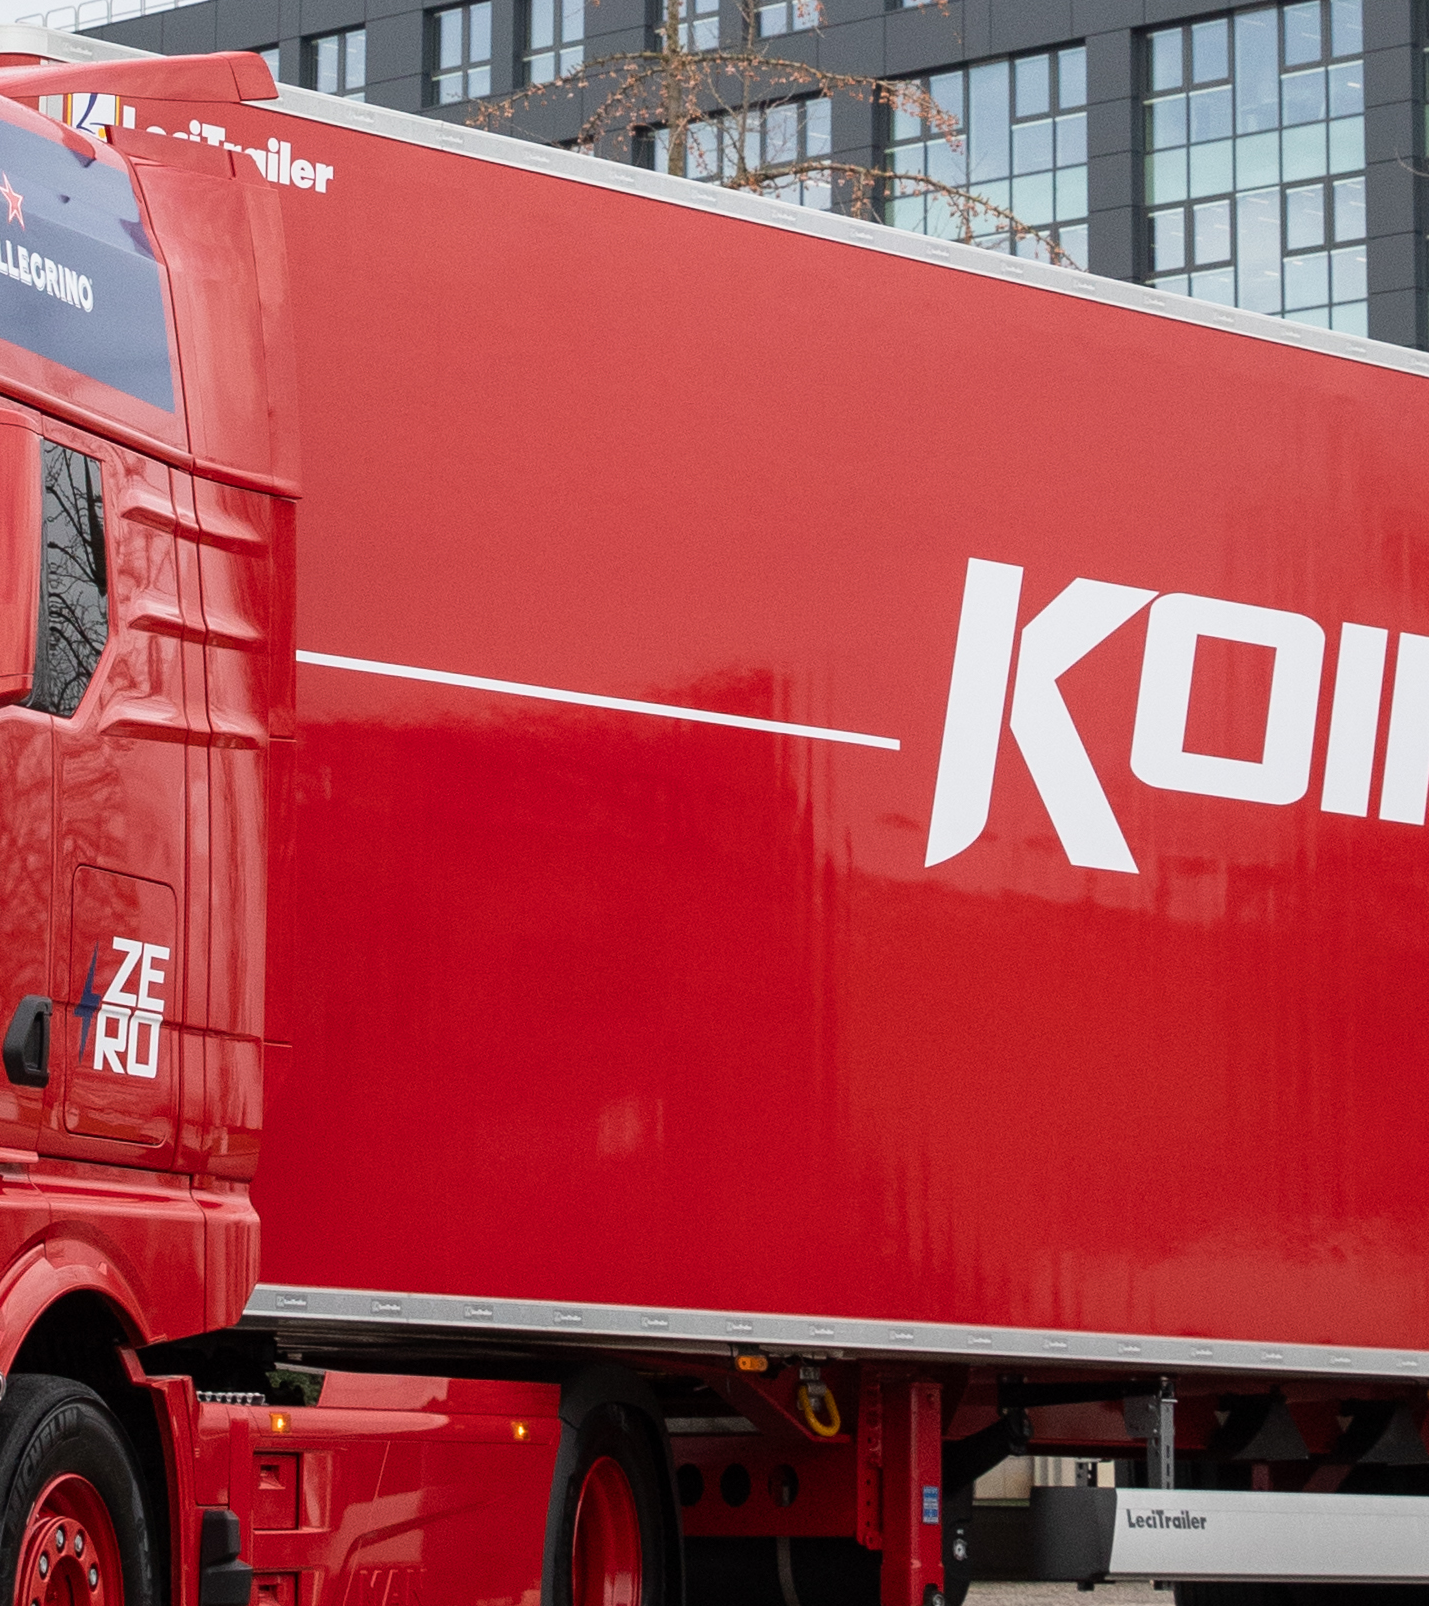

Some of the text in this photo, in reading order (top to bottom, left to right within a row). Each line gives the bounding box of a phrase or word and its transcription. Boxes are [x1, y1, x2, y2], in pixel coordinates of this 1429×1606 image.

[101, 936, 171, 1013] ZE
[92, 1003, 164, 1079] RO
[1126, 1508, 1207, 1530] LeciTrailer
